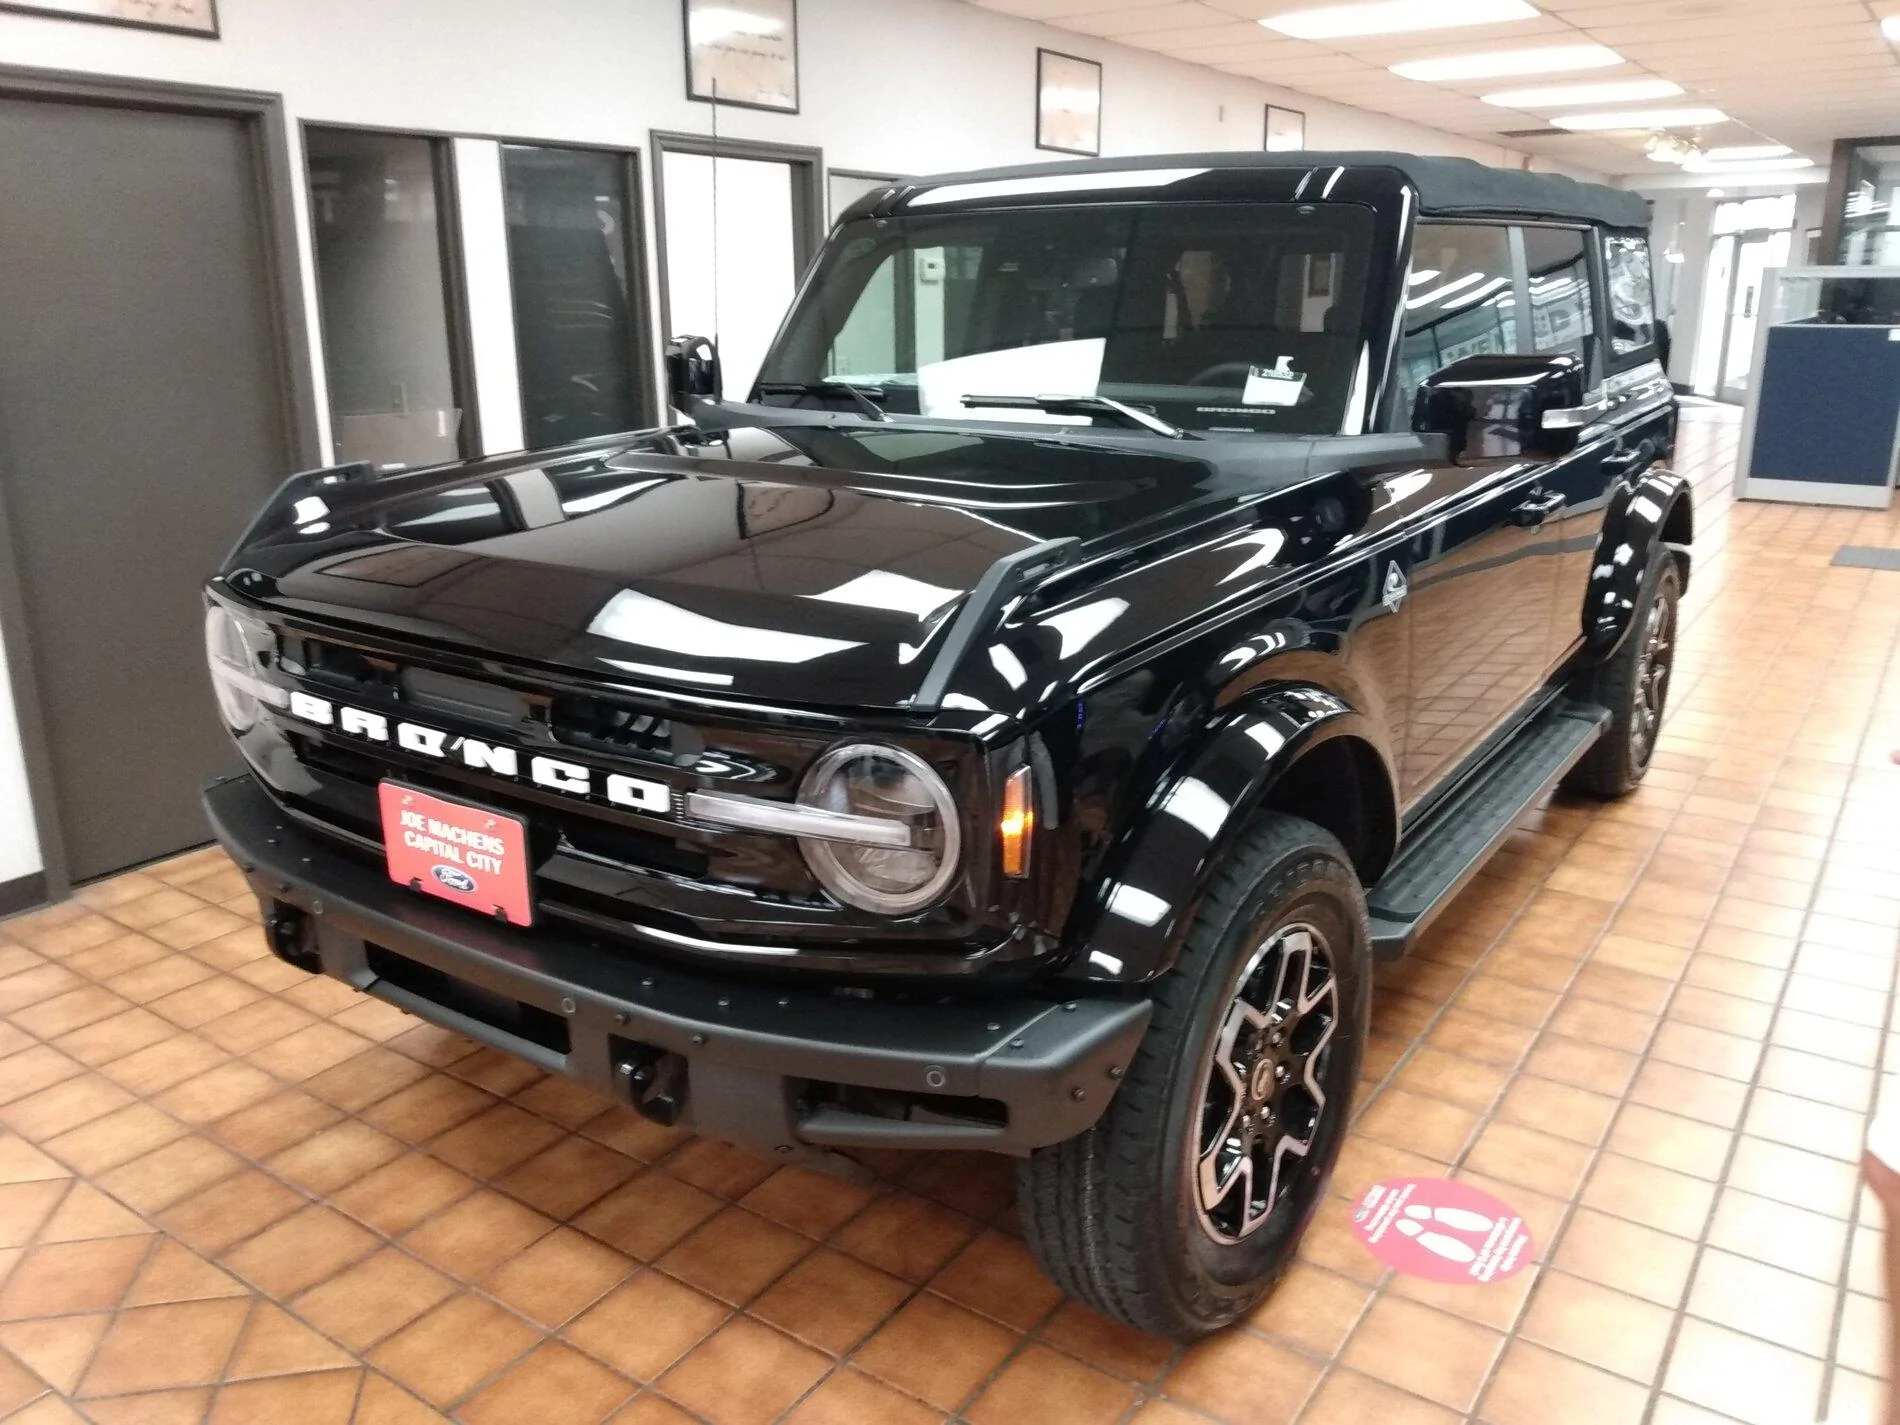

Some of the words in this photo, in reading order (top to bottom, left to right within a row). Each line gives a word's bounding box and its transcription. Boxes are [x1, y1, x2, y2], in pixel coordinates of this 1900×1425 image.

[290, 690, 671, 813] BRONCO
[400, 810, 428, 832] JOE
[428, 818, 505, 856] MACHENS
[404, 831, 464, 864] CAPITAL
[466, 850, 503, 876] CITY
